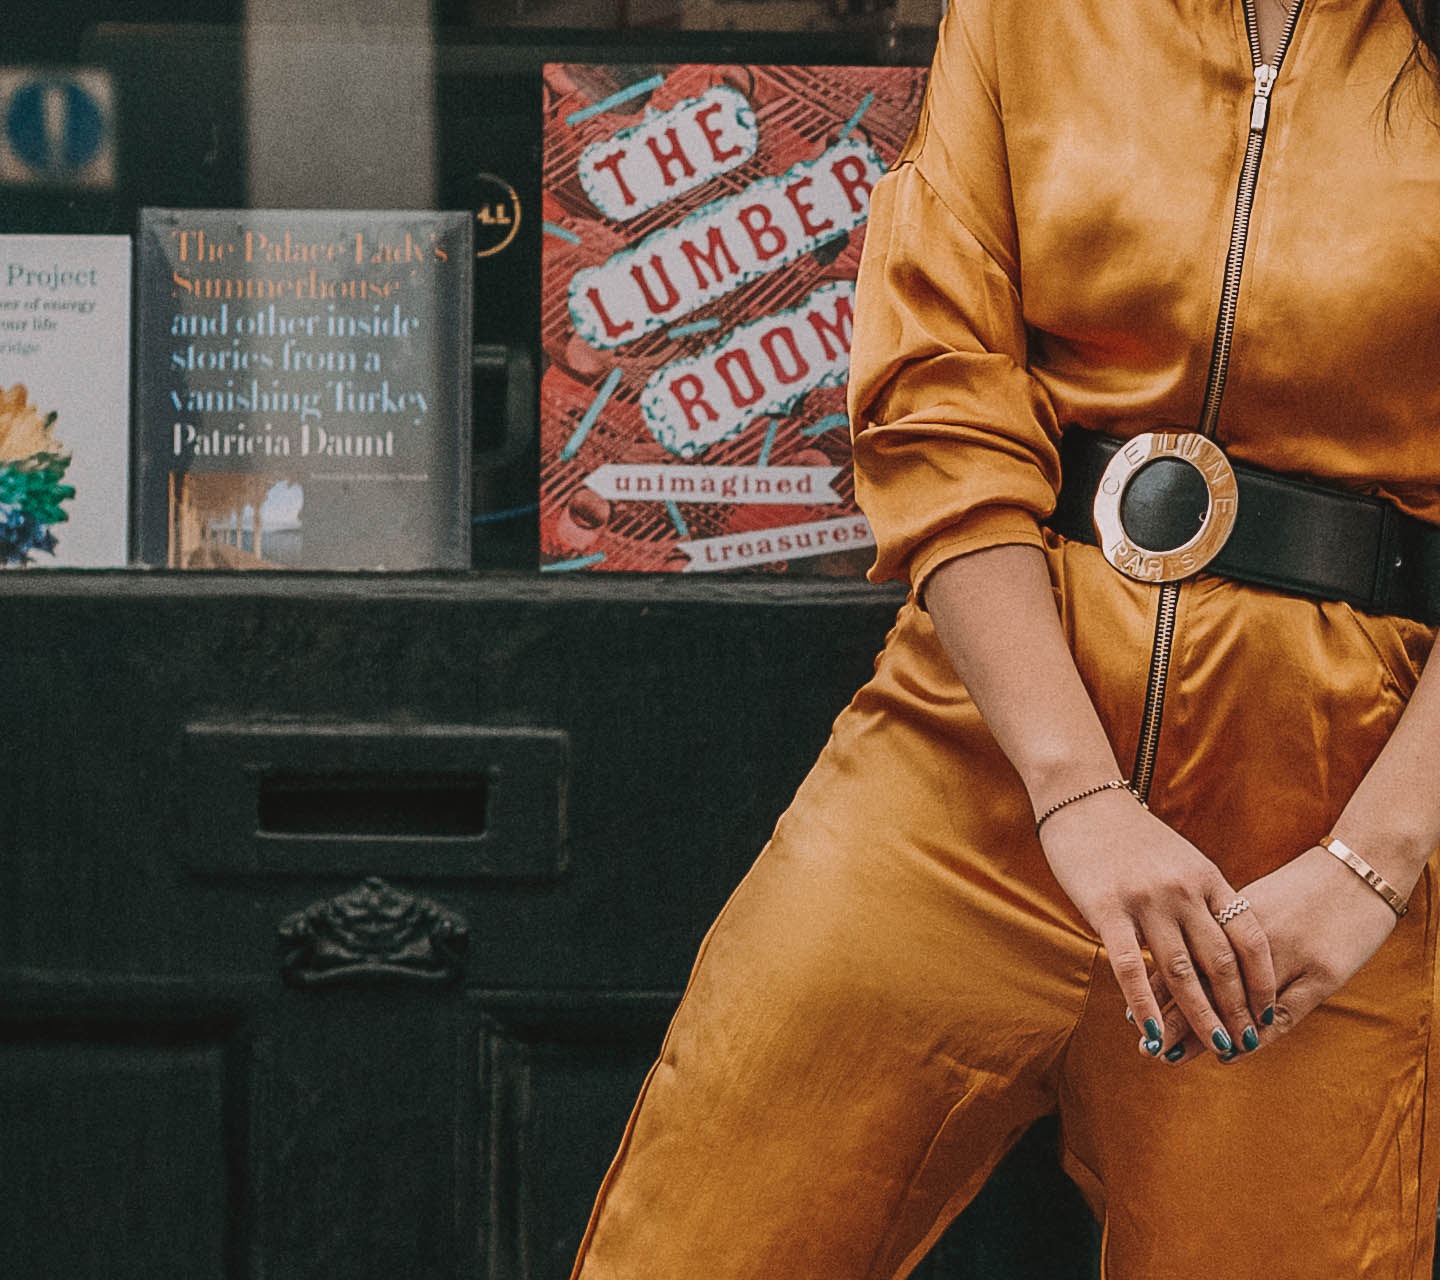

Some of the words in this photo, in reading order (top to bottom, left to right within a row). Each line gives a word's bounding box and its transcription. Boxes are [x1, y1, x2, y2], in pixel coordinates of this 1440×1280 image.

[592, 102, 743, 208] THE
[171, 230, 236, 264] The
[243, 231, 346, 265] Palace
[353, 232, 449, 269] Lady's
[585, 154, 873, 339] LUMBER
[6, 263, 99, 293] Project
[171, 270, 402, 300] Summerhouse
[24, 296, 39, 311] of
[171, 305, 232, 338] and
[235, 306, 321, 339] other
[326, 306, 422, 339] inside
[171, 344, 277, 372] stories
[282, 341, 358, 372] from
[362, 352, 382, 373] a
[667, 295, 854, 433] ROOM
[171, 383, 322, 419] vanishing
[328, 383, 429, 426] Turkey
[172, 423, 291, 458] Patricia
[301, 428, 394, 458] Daunt
[614, 473, 814, 497] unimagined
[703, 523, 871, 564] treasures
